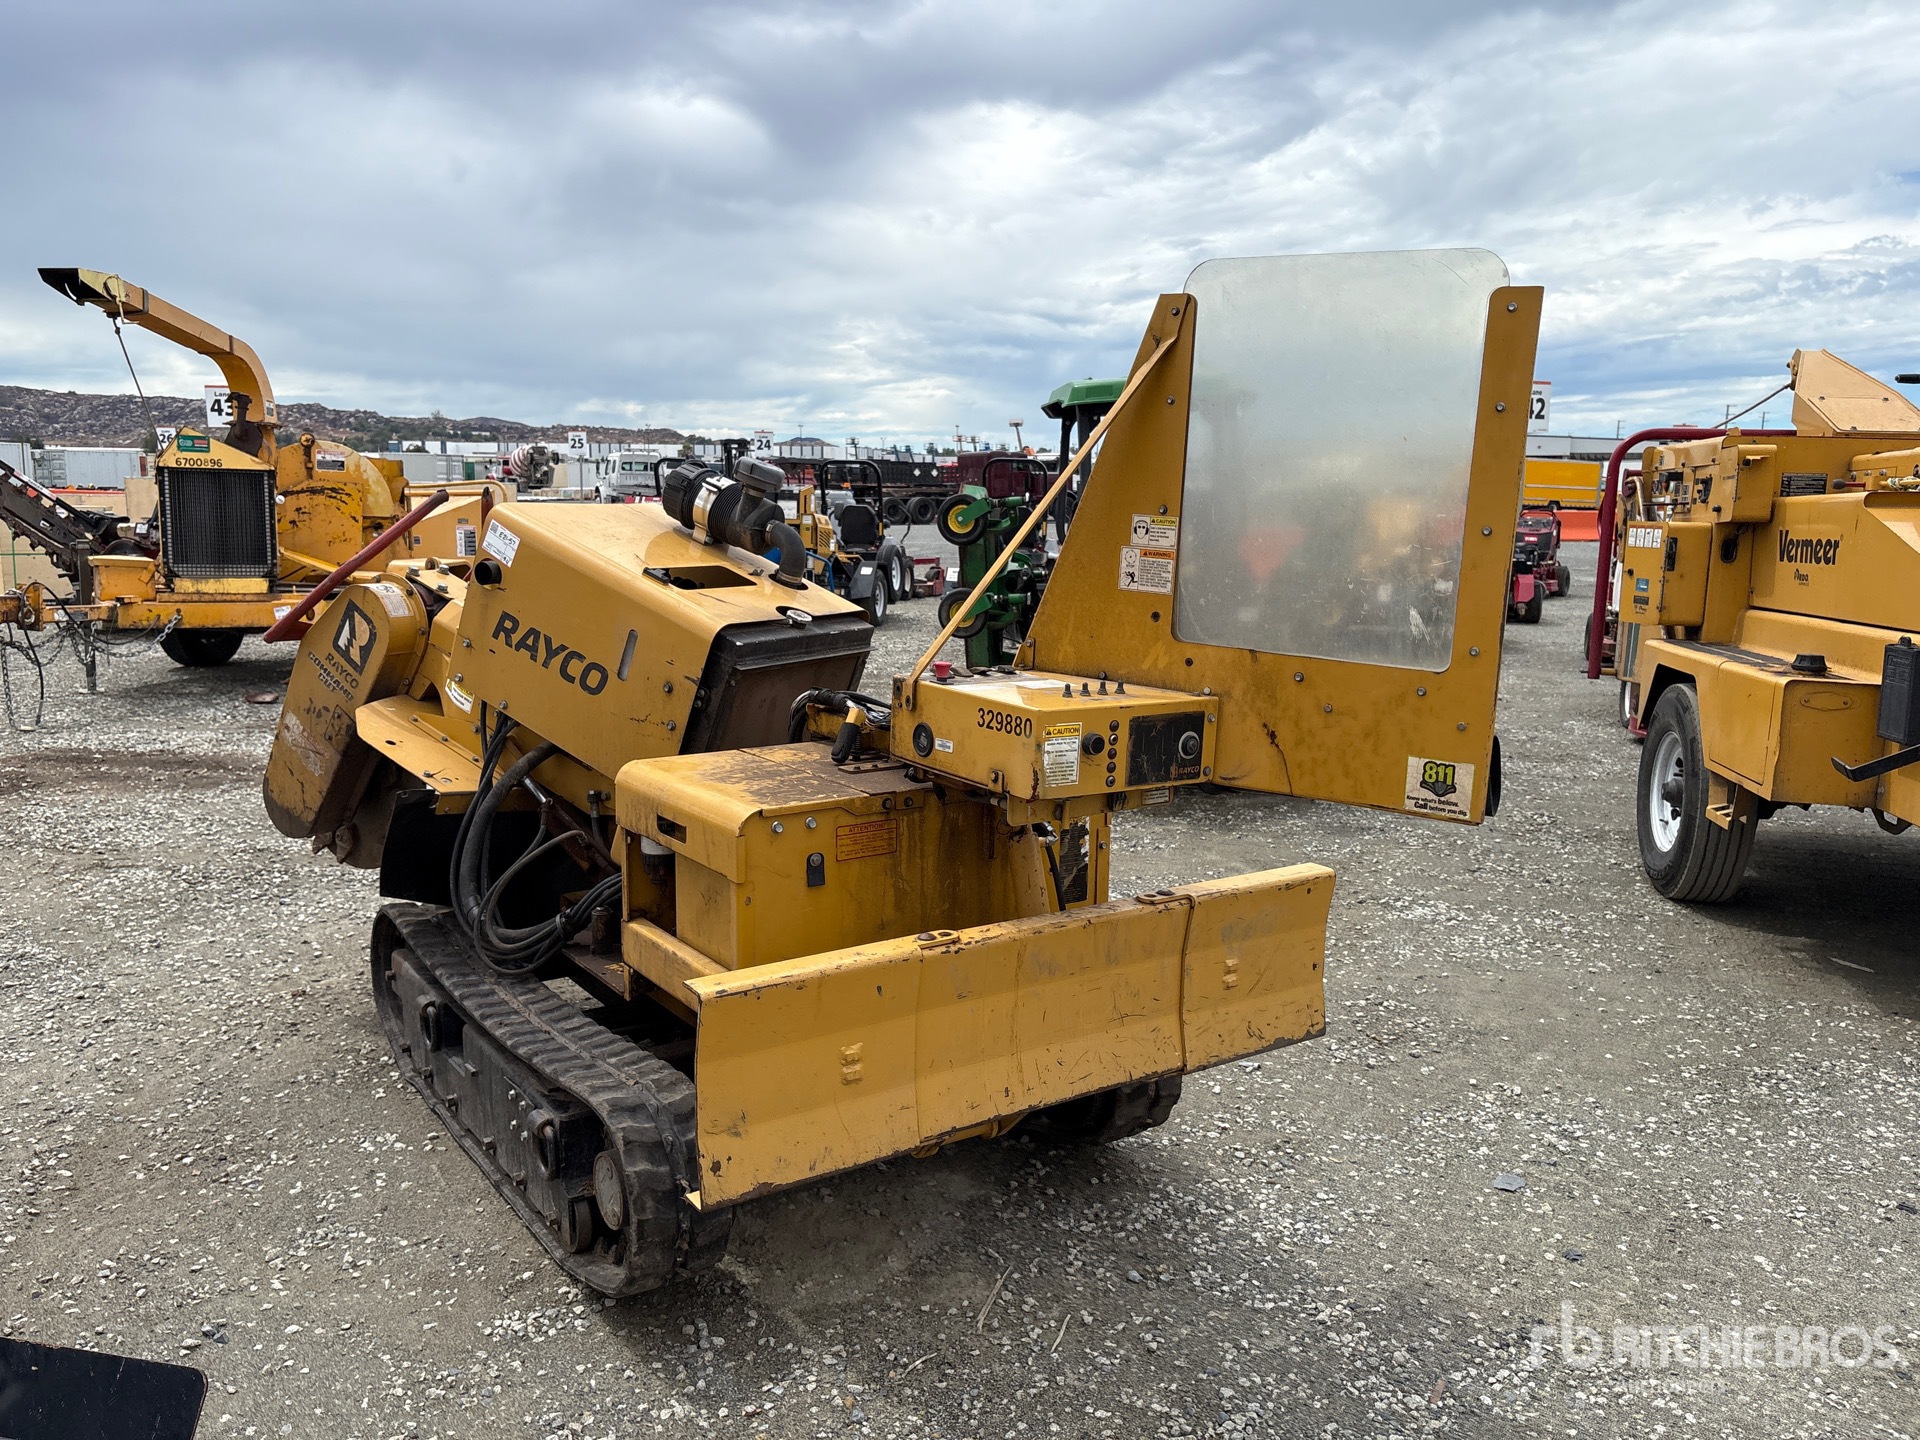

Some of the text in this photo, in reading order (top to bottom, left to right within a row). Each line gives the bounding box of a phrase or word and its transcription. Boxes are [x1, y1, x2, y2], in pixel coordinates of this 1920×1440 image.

[210, 398, 234, 416] 43
[159, 433, 173, 444] 26
[570, 438, 584, 449] 25
[756, 439, 771, 450] 24
[175, 457, 223, 468] 6700896
[1779, 529, 1840, 565] Vermeer
[491, 610, 609, 696] RAYCO
[307, 651, 354, 702] COMMAND
[325, 652, 359, 689] RAYCO
[318, 673, 338, 693] CUT
[977, 707, 1033, 739] 329880
[1052, 727, 1079, 735] CAUTION
[1178, 765, 1200, 774] RAYCO
[1424, 762, 1454, 786] 811
[1414, 801, 1428, 810] Call
[1429, 805, 1446, 813] before
